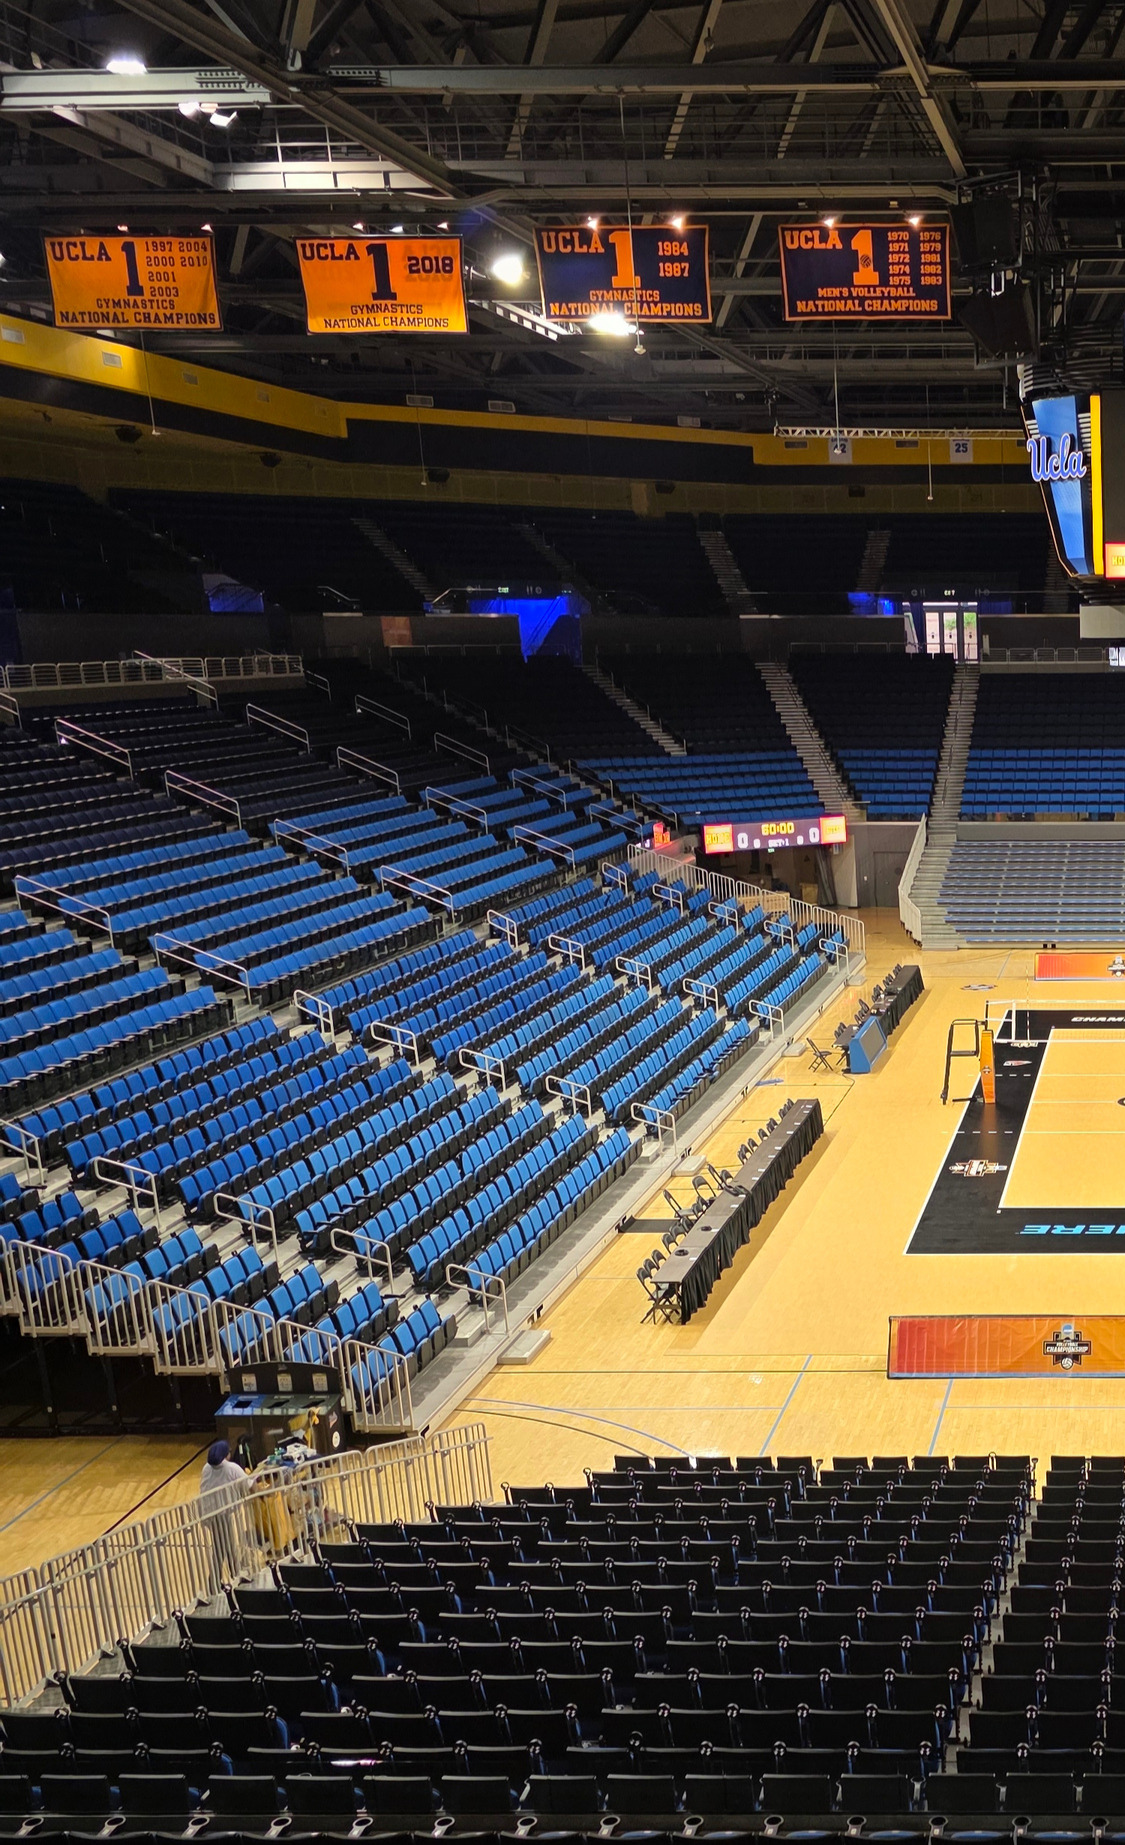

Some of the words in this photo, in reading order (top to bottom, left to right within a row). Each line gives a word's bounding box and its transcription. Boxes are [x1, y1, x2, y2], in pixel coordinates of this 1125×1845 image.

[888, 232, 909, 240] 1970
[145, 241, 172, 252] 1997
[178, 241, 208, 252] 2004
[658, 242, 689, 256] 1984
[889, 243, 908, 252] 1971
[146, 256, 175, 267] 2000
[181, 256, 207, 267] 2010
[542, 231, 604, 253] UCLA
[609, 231, 641, 288] 1
[785, 230, 842, 249] UCLA
[851, 230, 879, 285] 1
[888, 254, 910, 263] 1972
[50, 242, 112, 262] UCLA
[121, 241, 144, 296] 1
[408, 256, 454, 274] 2018
[659, 262, 689, 277] 1987
[889, 265, 910, 274] 1974
[148, 271, 176, 282] 2001
[300, 243, 360, 261] UCLA
[366, 243, 397, 301] 1
[889, 276, 910, 285] 1975
[150, 286, 179, 297] 2003
[589, 290, 660, 301] GYMNASTICS
[818, 288, 848, 297] MEN'S
[851, 287, 915, 297] VOLLEYBALL
[96, 298, 175, 310] GYMNASTICS
[350, 304, 423, 315] GYMNASTICS
[550, 303, 618, 316] NATIONAL
[624, 303, 702, 316] CHAMPIONS
[797, 301, 862, 312] NATIONAL
[865, 300, 938, 311] CHAMPIONS
[60, 311, 129, 324] NATIONAL
[134, 312, 216, 324] CHAMPIONS
[324, 317, 380, 328] NATIONAL
[384, 317, 449, 328] CHAMPIONS
[955, 443, 968, 453] 25
[761, 822, 794, 835] 60:00
[809, 827, 820, 842] 0
[737, 833, 748, 848] 0
